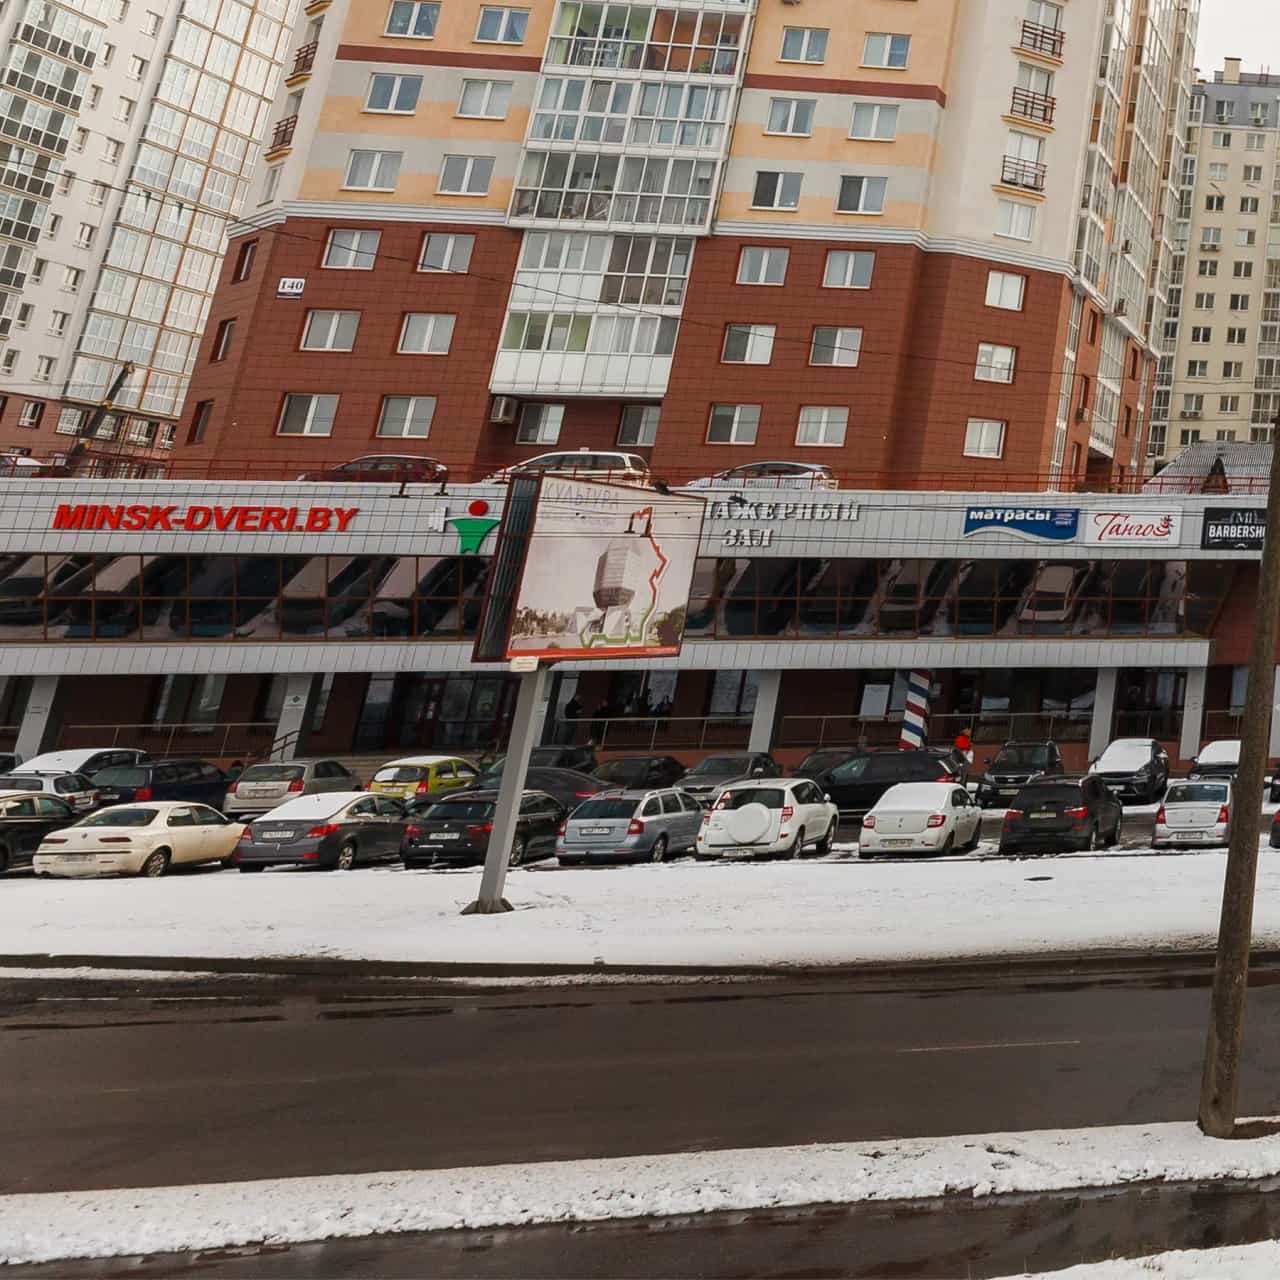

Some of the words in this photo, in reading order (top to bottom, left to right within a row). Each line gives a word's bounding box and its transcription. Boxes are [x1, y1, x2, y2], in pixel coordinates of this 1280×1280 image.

[52, 504, 360, 531] MINSK-DVERI.BY
[969, 509, 1051, 522] матрасы
[1094, 513, 1156, 540] Танго
[723, 528, 773, 547] ЗАЛ
